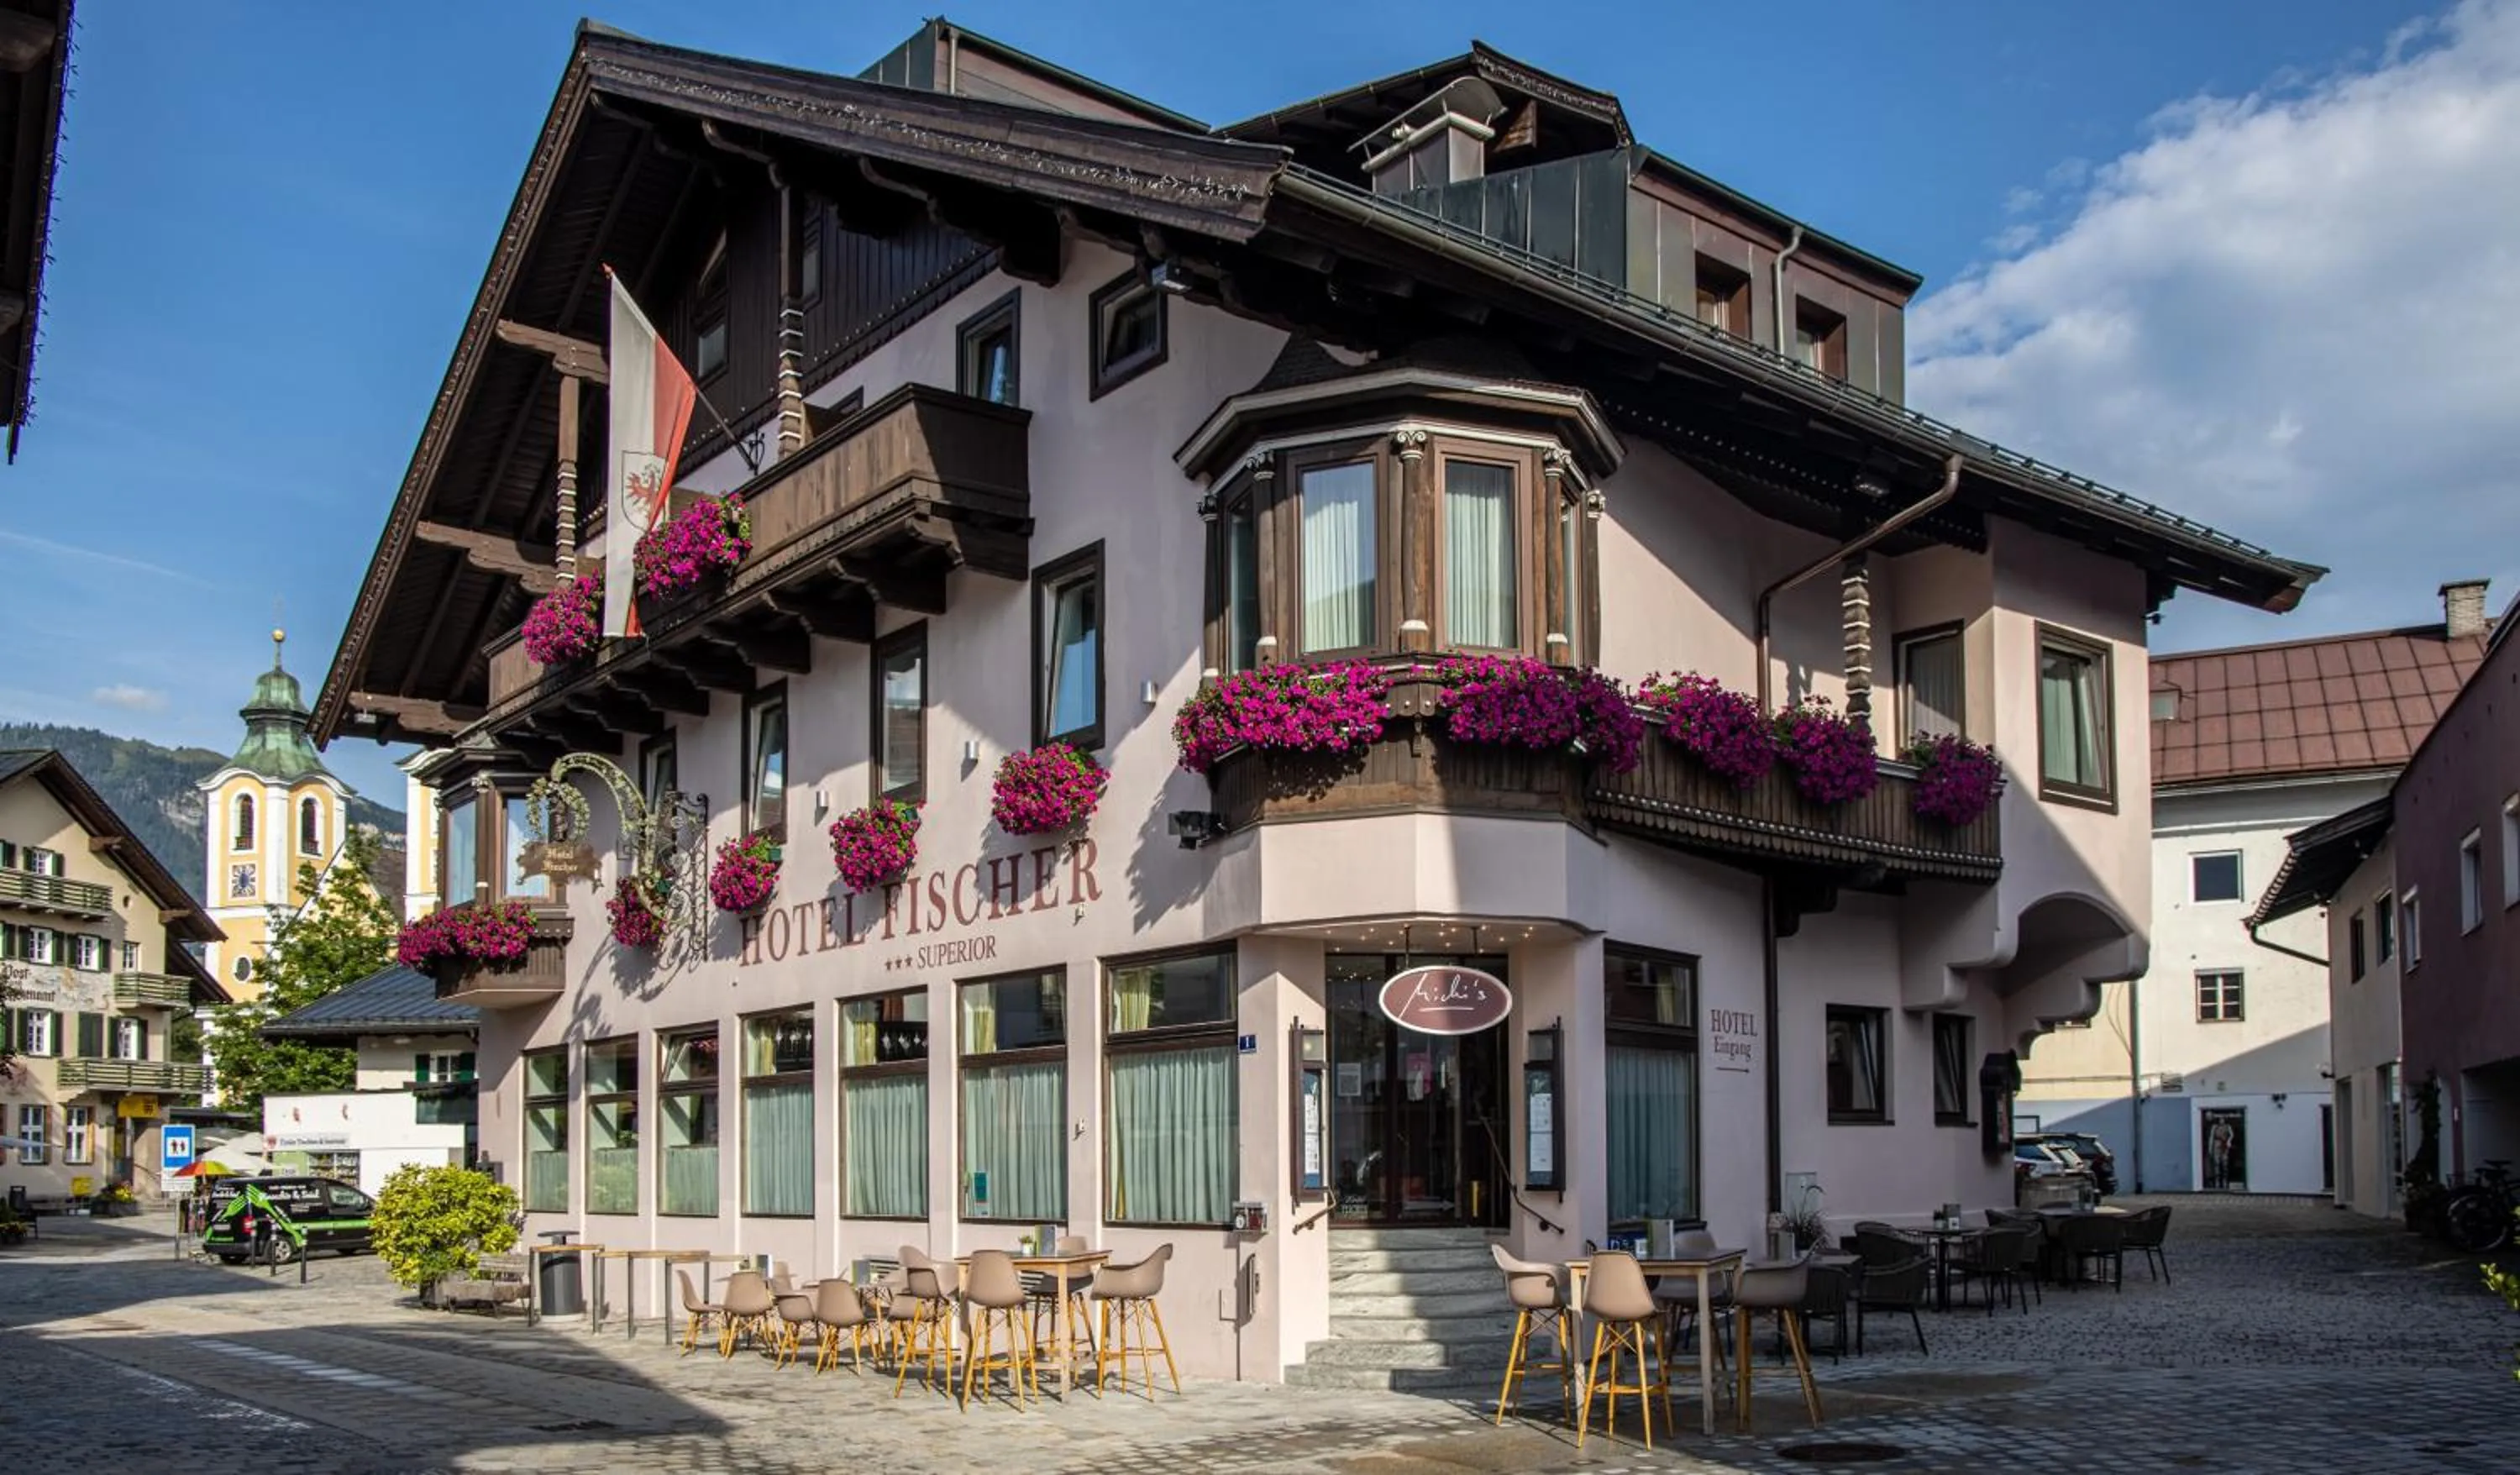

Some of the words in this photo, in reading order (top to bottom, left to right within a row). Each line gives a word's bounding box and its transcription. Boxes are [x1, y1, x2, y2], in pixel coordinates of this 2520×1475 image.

[738, 891, 868, 967] HOTEL
[879, 837, 1104, 942] FISCHER
[917, 935, 997, 969] SUPERIOR
[1710, 1009, 1758, 1037] HOTEL
[1714, 1036, 1751, 1063] Eingang
